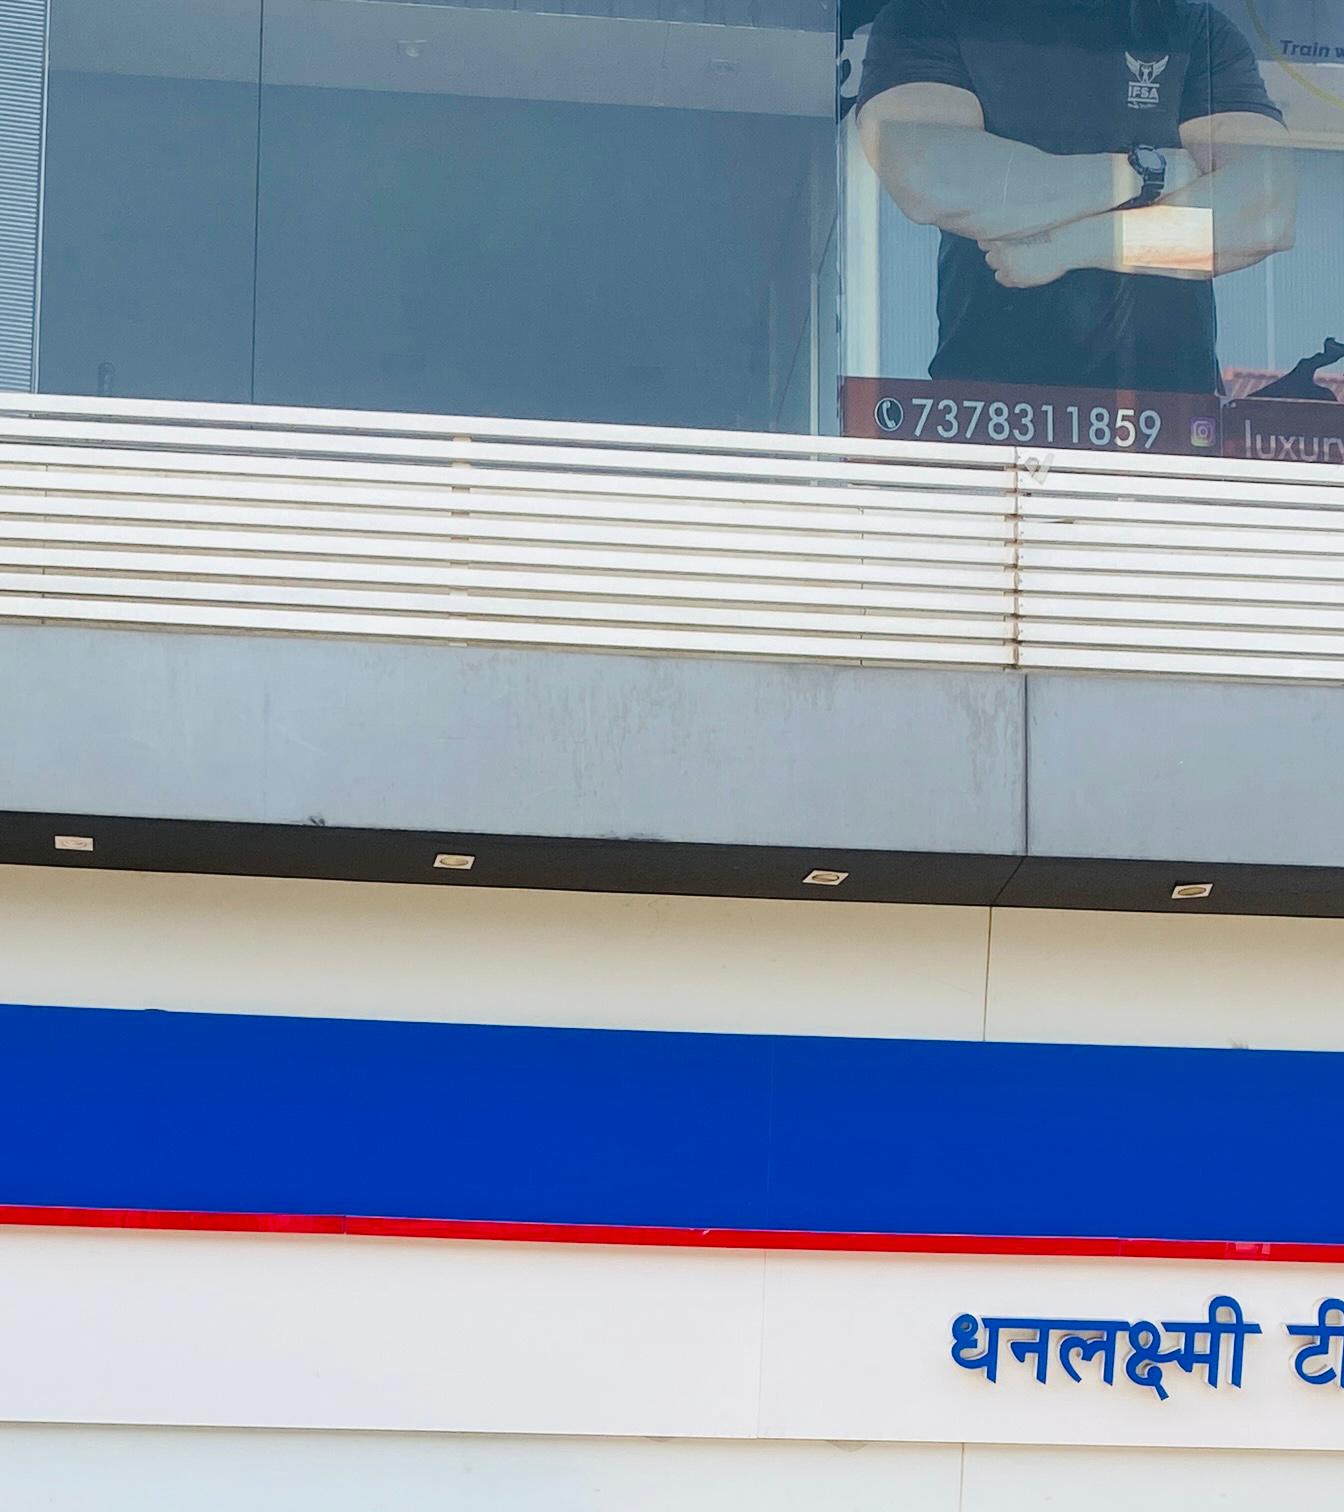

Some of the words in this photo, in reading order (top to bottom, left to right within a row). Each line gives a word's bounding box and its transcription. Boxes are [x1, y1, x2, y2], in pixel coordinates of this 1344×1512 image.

[1280, 40, 1330, 58] Train
[912, 398, 1162, 449] 7378311859
[951, 1295, 1262, 1400] धनलक्ष्मी
